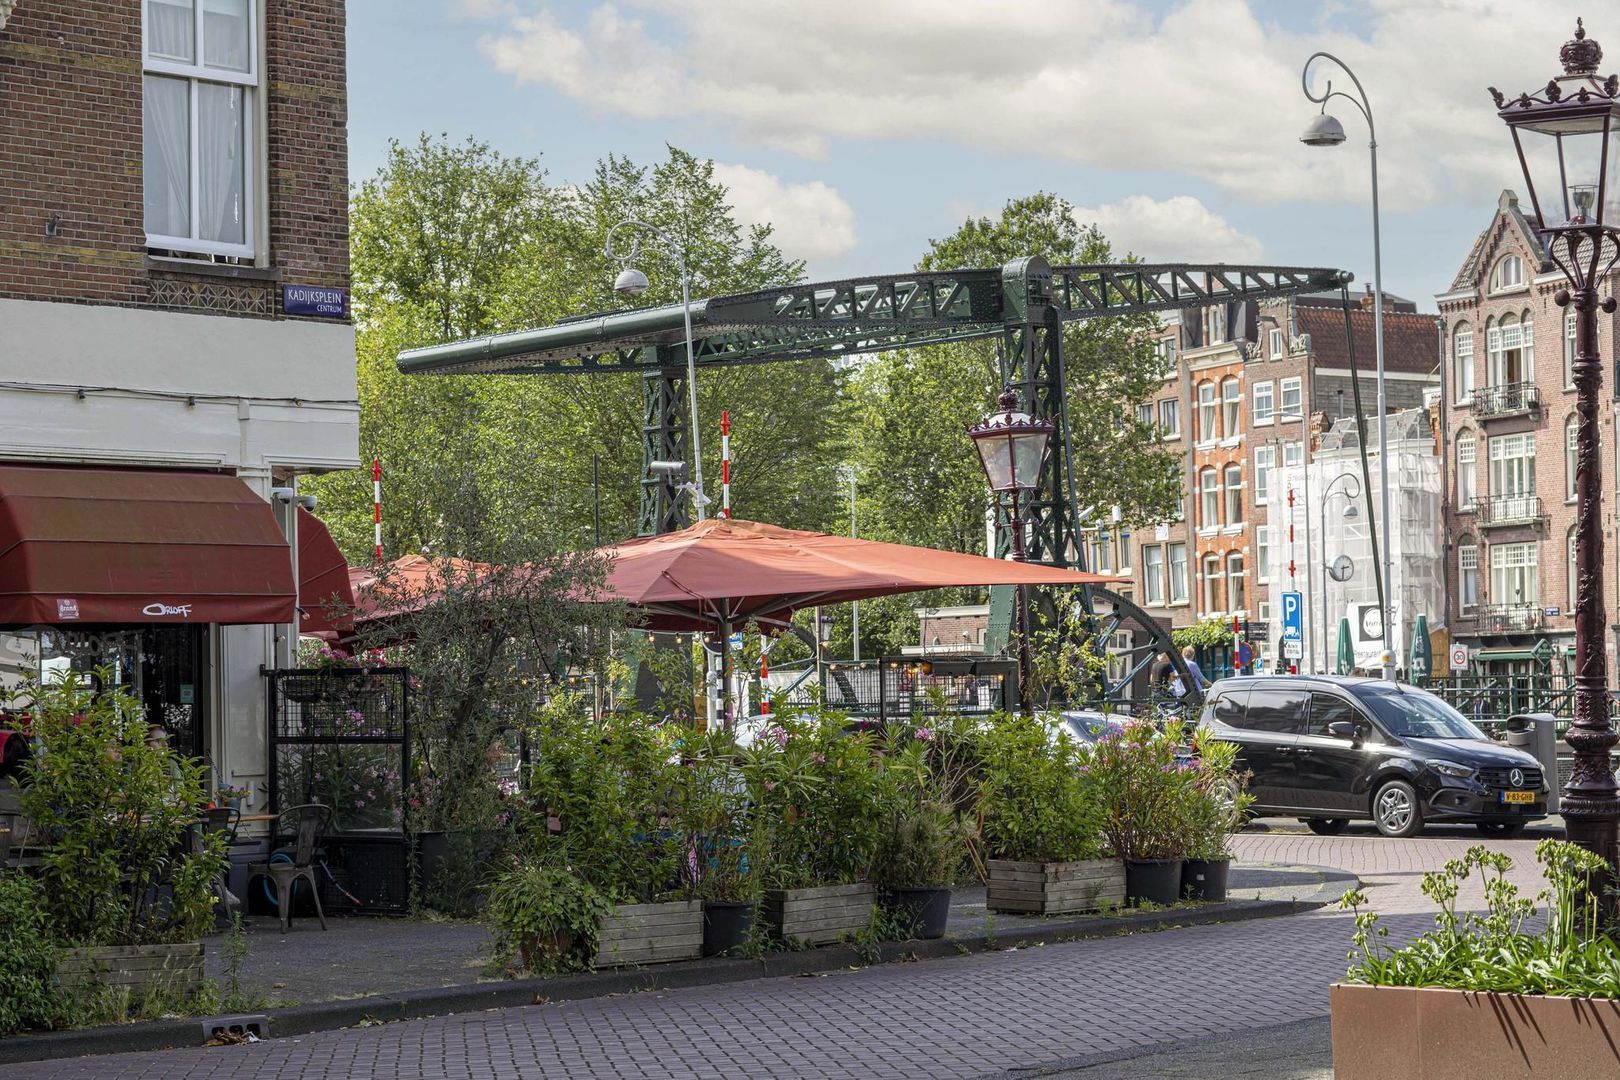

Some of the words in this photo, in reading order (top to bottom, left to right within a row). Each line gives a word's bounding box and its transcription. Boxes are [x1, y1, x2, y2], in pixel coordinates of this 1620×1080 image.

[288, 289, 342, 304] KADIJKSPLEIN
[316, 304, 342, 313] CENTRUM
[1285, 596, 1297, 621] P
[1455, 653, 1464, 661] 30
